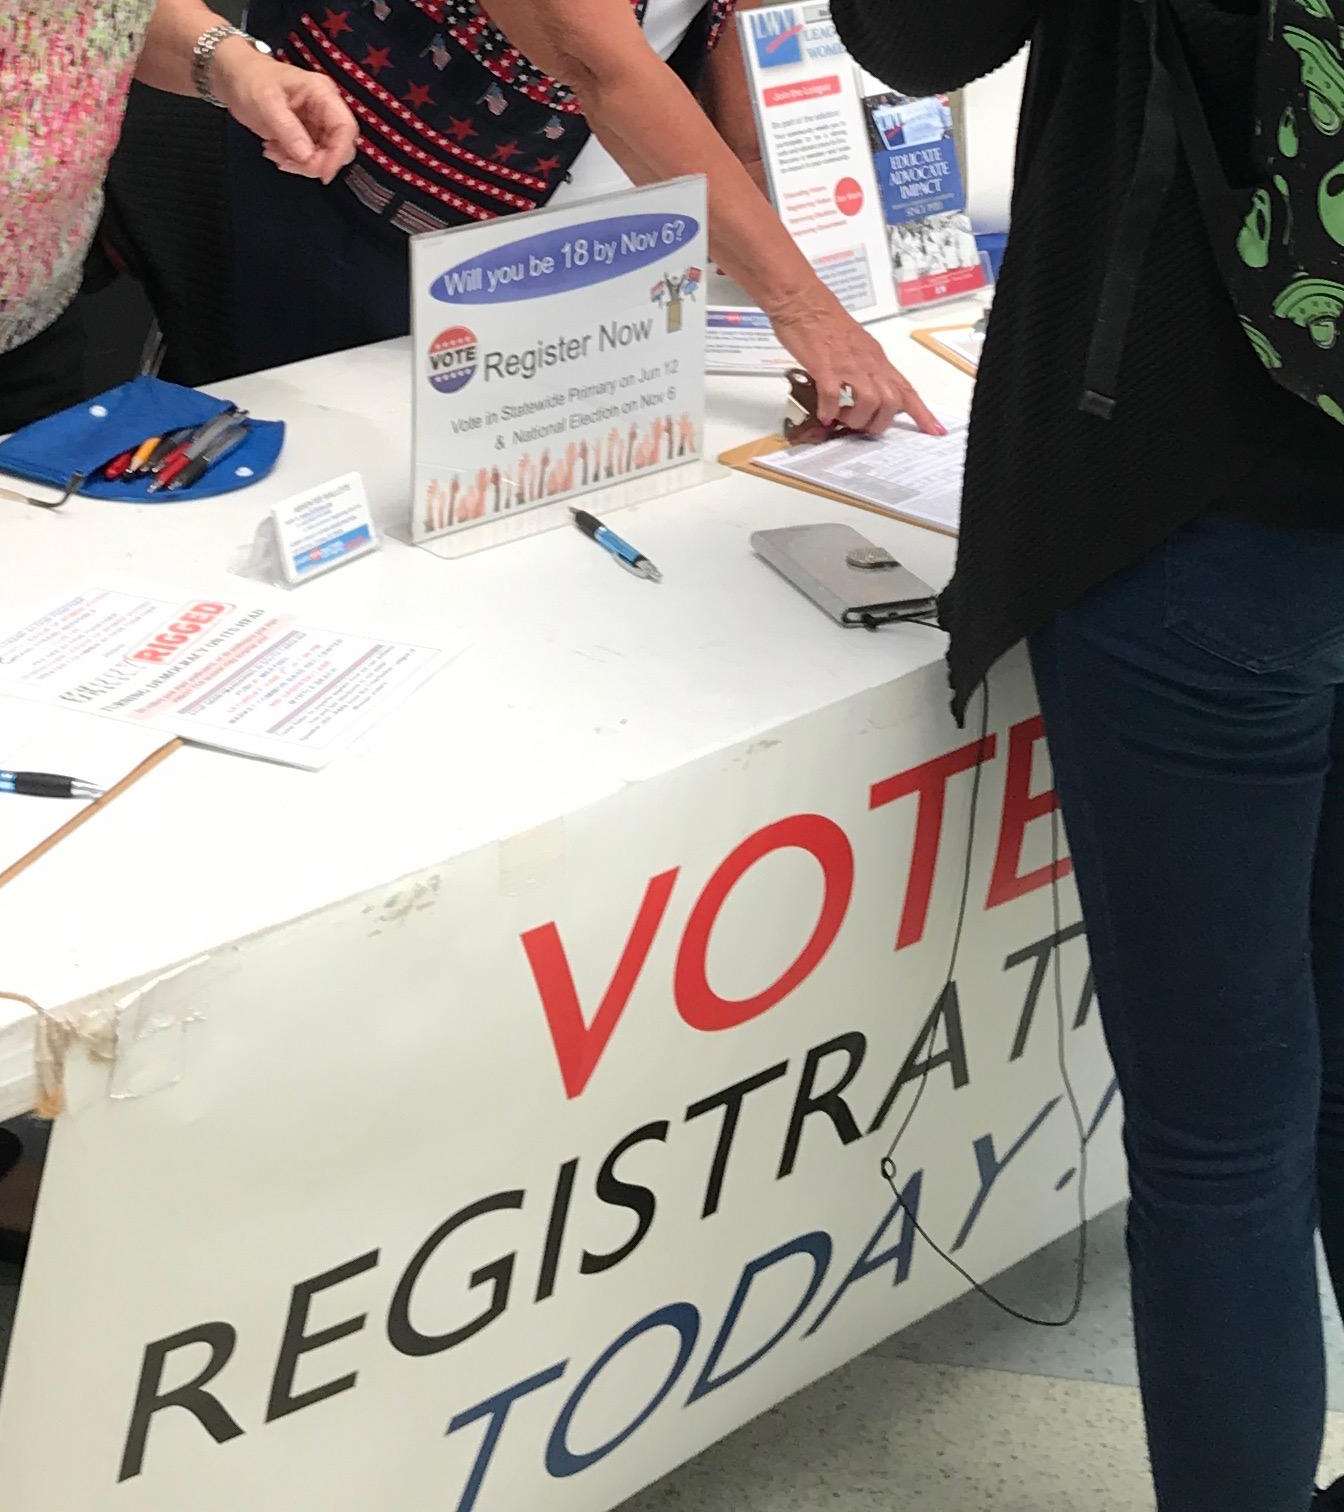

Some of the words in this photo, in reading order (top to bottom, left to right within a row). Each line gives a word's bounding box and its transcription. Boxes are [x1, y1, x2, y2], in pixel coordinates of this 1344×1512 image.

[888, 161, 951, 187] ADVOCATE
[889, 148, 943, 171] EDUCATE
[899, 178, 943, 200] IMPACT
[444, 267, 483, 296] Will
[487, 265, 525, 293] you
[529, 255, 555, 277] be
[561, 238, 589, 269] 18
[593, 239, 617, 265] by
[620, 231, 659, 256] Nov
[660, 219, 686, 245] 6?
[429, 345, 477, 370] VOTE
[484, 332, 592, 381] Register
[598, 318, 654, 352] Now
[451, 414, 483, 434] Vote
[484, 411, 499, 425] in
[500, 394, 566, 421] Statewide
[567, 377, 618, 403] Primary
[618, 374, 637, 389] on
[637, 366, 661, 384] Jun
[664, 358, 680, 375] 12
[512, 418, 568, 446] National
[568, 403, 620, 431] Election
[621, 399, 639, 415] on
[639, 391, 665, 410] Nov
[666, 386, 677, 401] 6
[133, 600, 226, 665] RIGGED
